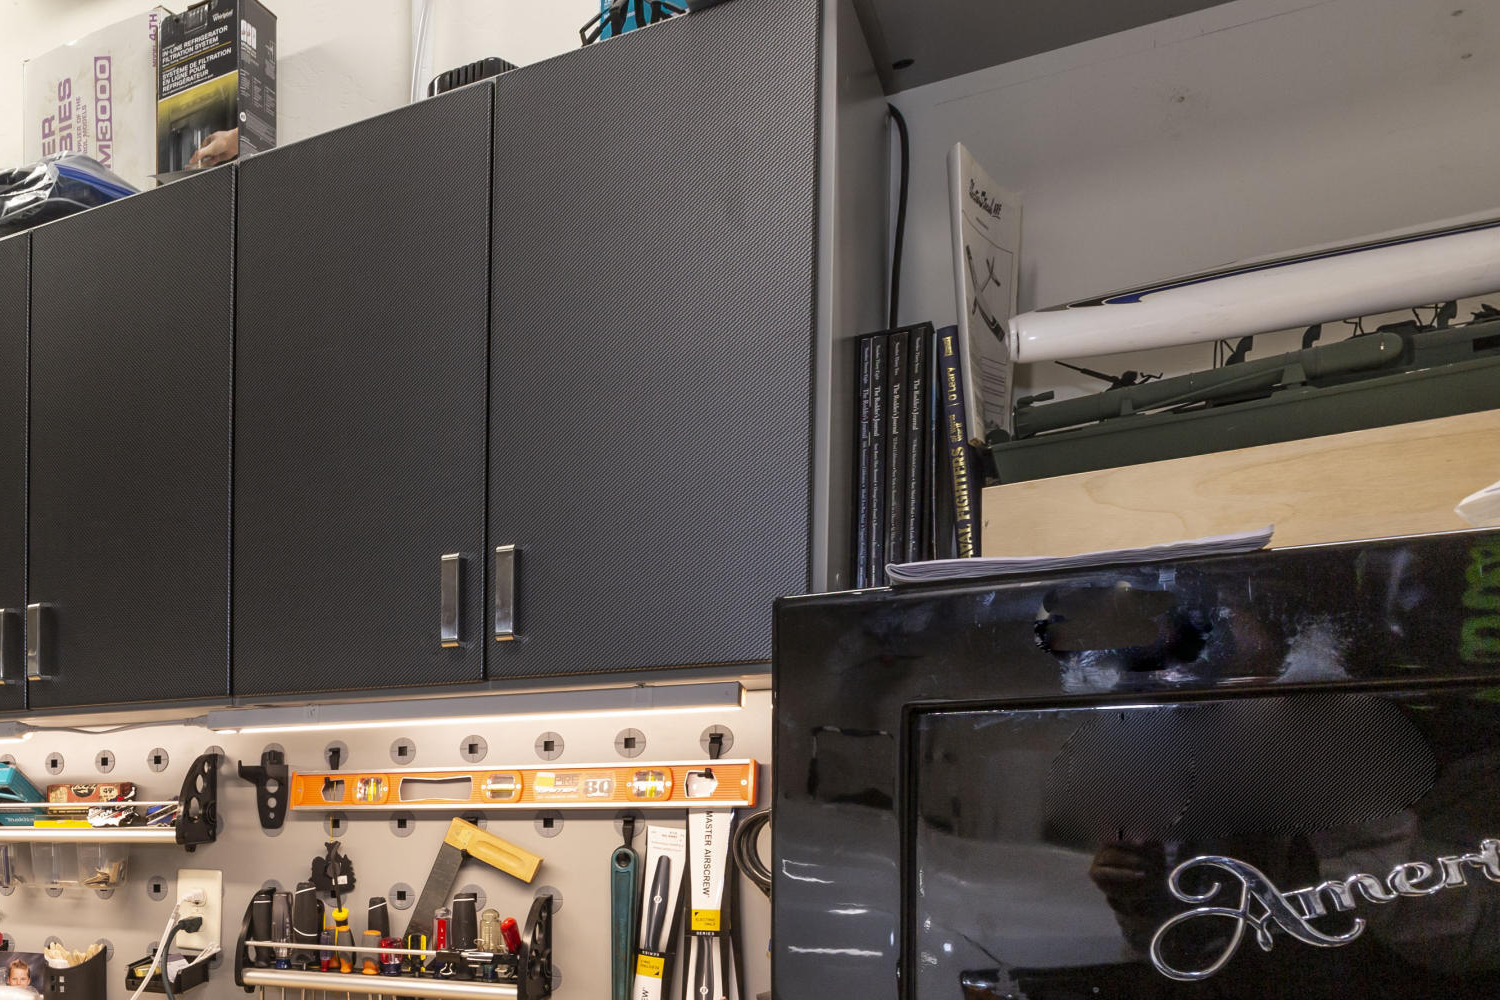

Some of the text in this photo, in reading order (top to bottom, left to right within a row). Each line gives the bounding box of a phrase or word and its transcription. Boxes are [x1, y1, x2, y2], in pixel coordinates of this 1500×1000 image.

[183, 25, 228, 47] REFRIGERATOR
[162, 45, 193, 64] FILTRATION
[194, 36, 219, 50] SYSTEM
[189, 60, 197, 69] DE
[198, 47, 232, 65] FILTRATION
[162, 63, 206, 87] EN LIGNE POUR
[57, 77, 73, 152] BIES
[42, 115, 56, 158] ER
[891, 416, 899, 434] Journal
[912, 412, 920, 431] Journal
[951, 446, 974, 559] AVAL FIGHTERS
[702, 810, 714, 896] MASTER AIRSCREW
